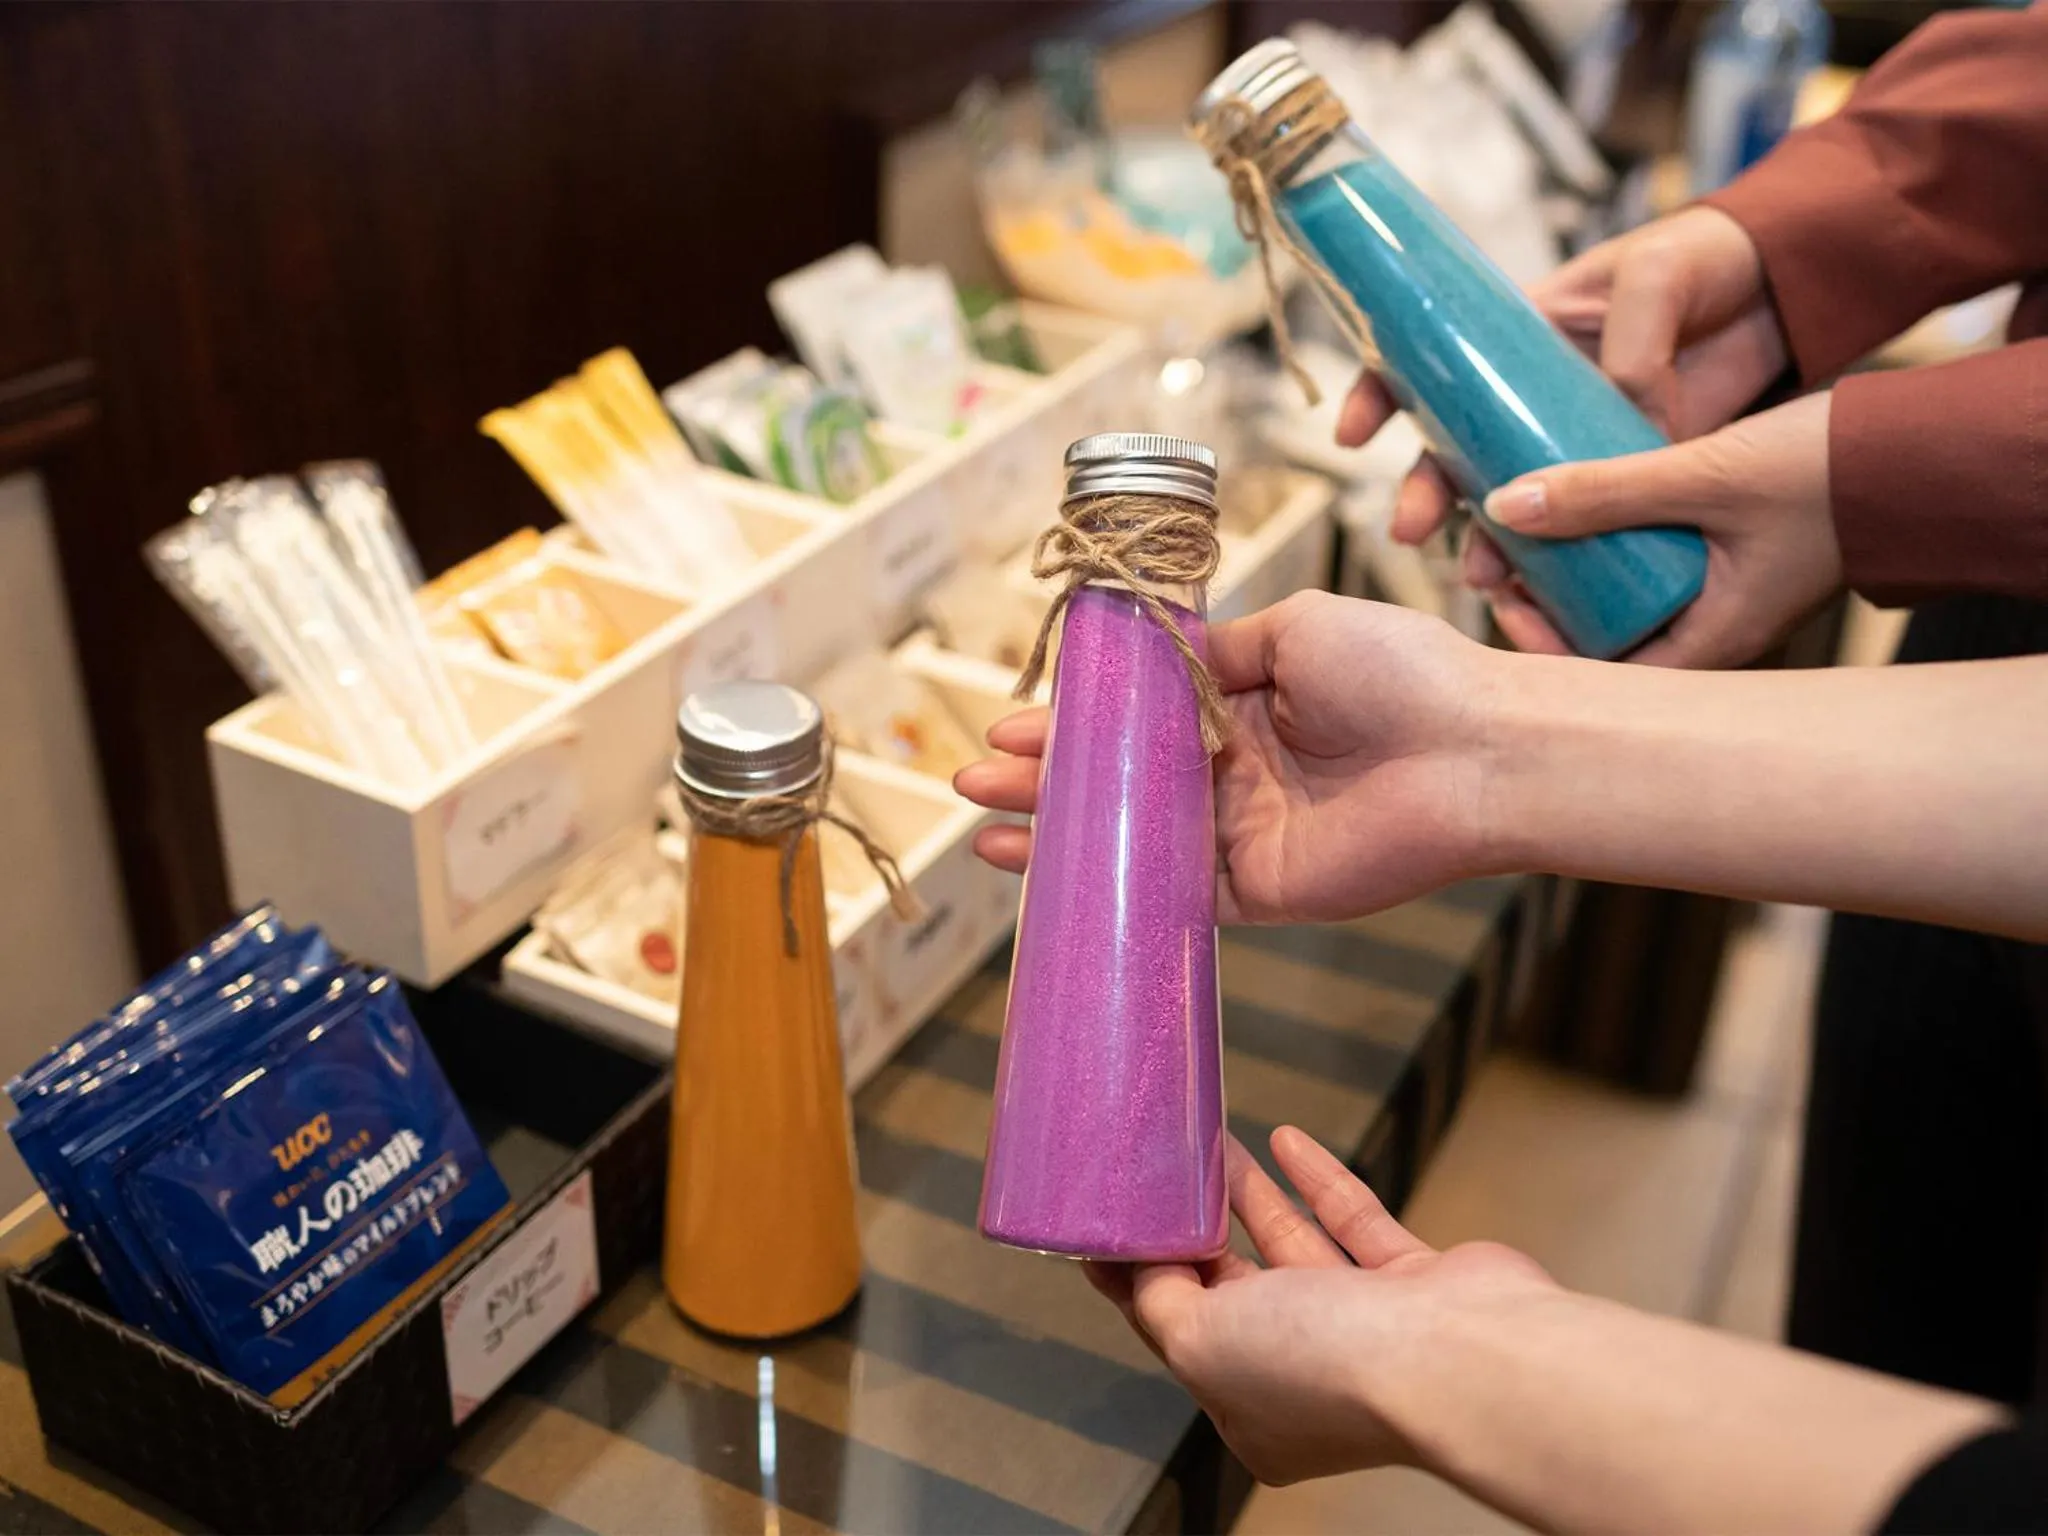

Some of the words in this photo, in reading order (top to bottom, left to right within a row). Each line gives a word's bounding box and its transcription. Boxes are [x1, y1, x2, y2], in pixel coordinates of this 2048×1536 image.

[250, 1128, 425, 1274] 職人の珈琲
[260, 1161, 461, 1329] まろやか味のマイルドブレンド
